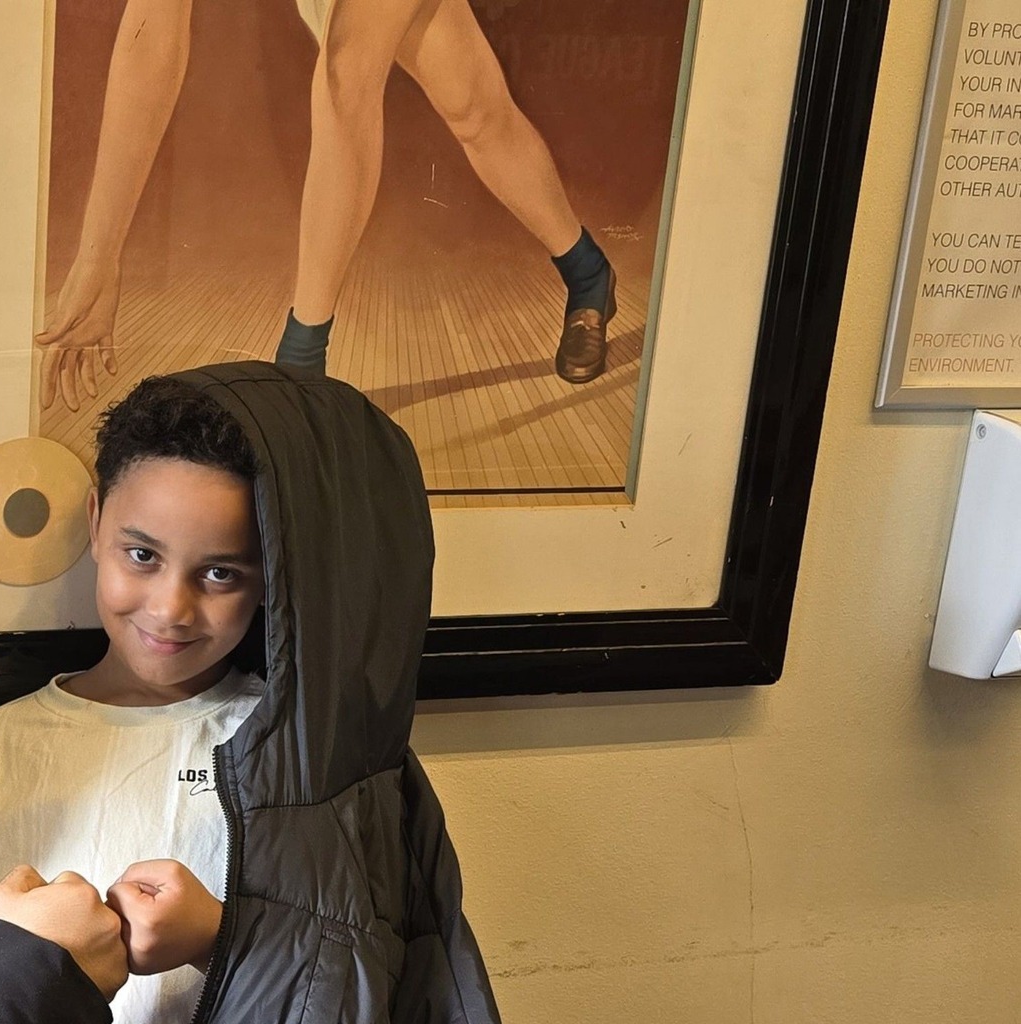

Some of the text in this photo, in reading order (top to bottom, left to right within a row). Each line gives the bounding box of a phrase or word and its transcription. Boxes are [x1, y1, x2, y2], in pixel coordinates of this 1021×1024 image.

[968, 22, 989, 38] BY
[960, 75, 1021, 93] YOUR IN
[953, 102, 985, 118] FOR
[951, 129, 1021, 146] THAT IT C
[944, 155, 1021, 171] COOPERA
[940, 181, 992, 196] OTHER
[932, 233, 1021, 249] YOU CAN TE
[928, 258, 1021, 274] YOU DO NOT
[921, 284, 1008, 299] MARKETING
[912, 333, 1021, 348] PROTECTING Y
[908, 358, 1014, 373] ENVIRONMENT.
[178, 769, 208, 782] LOS
